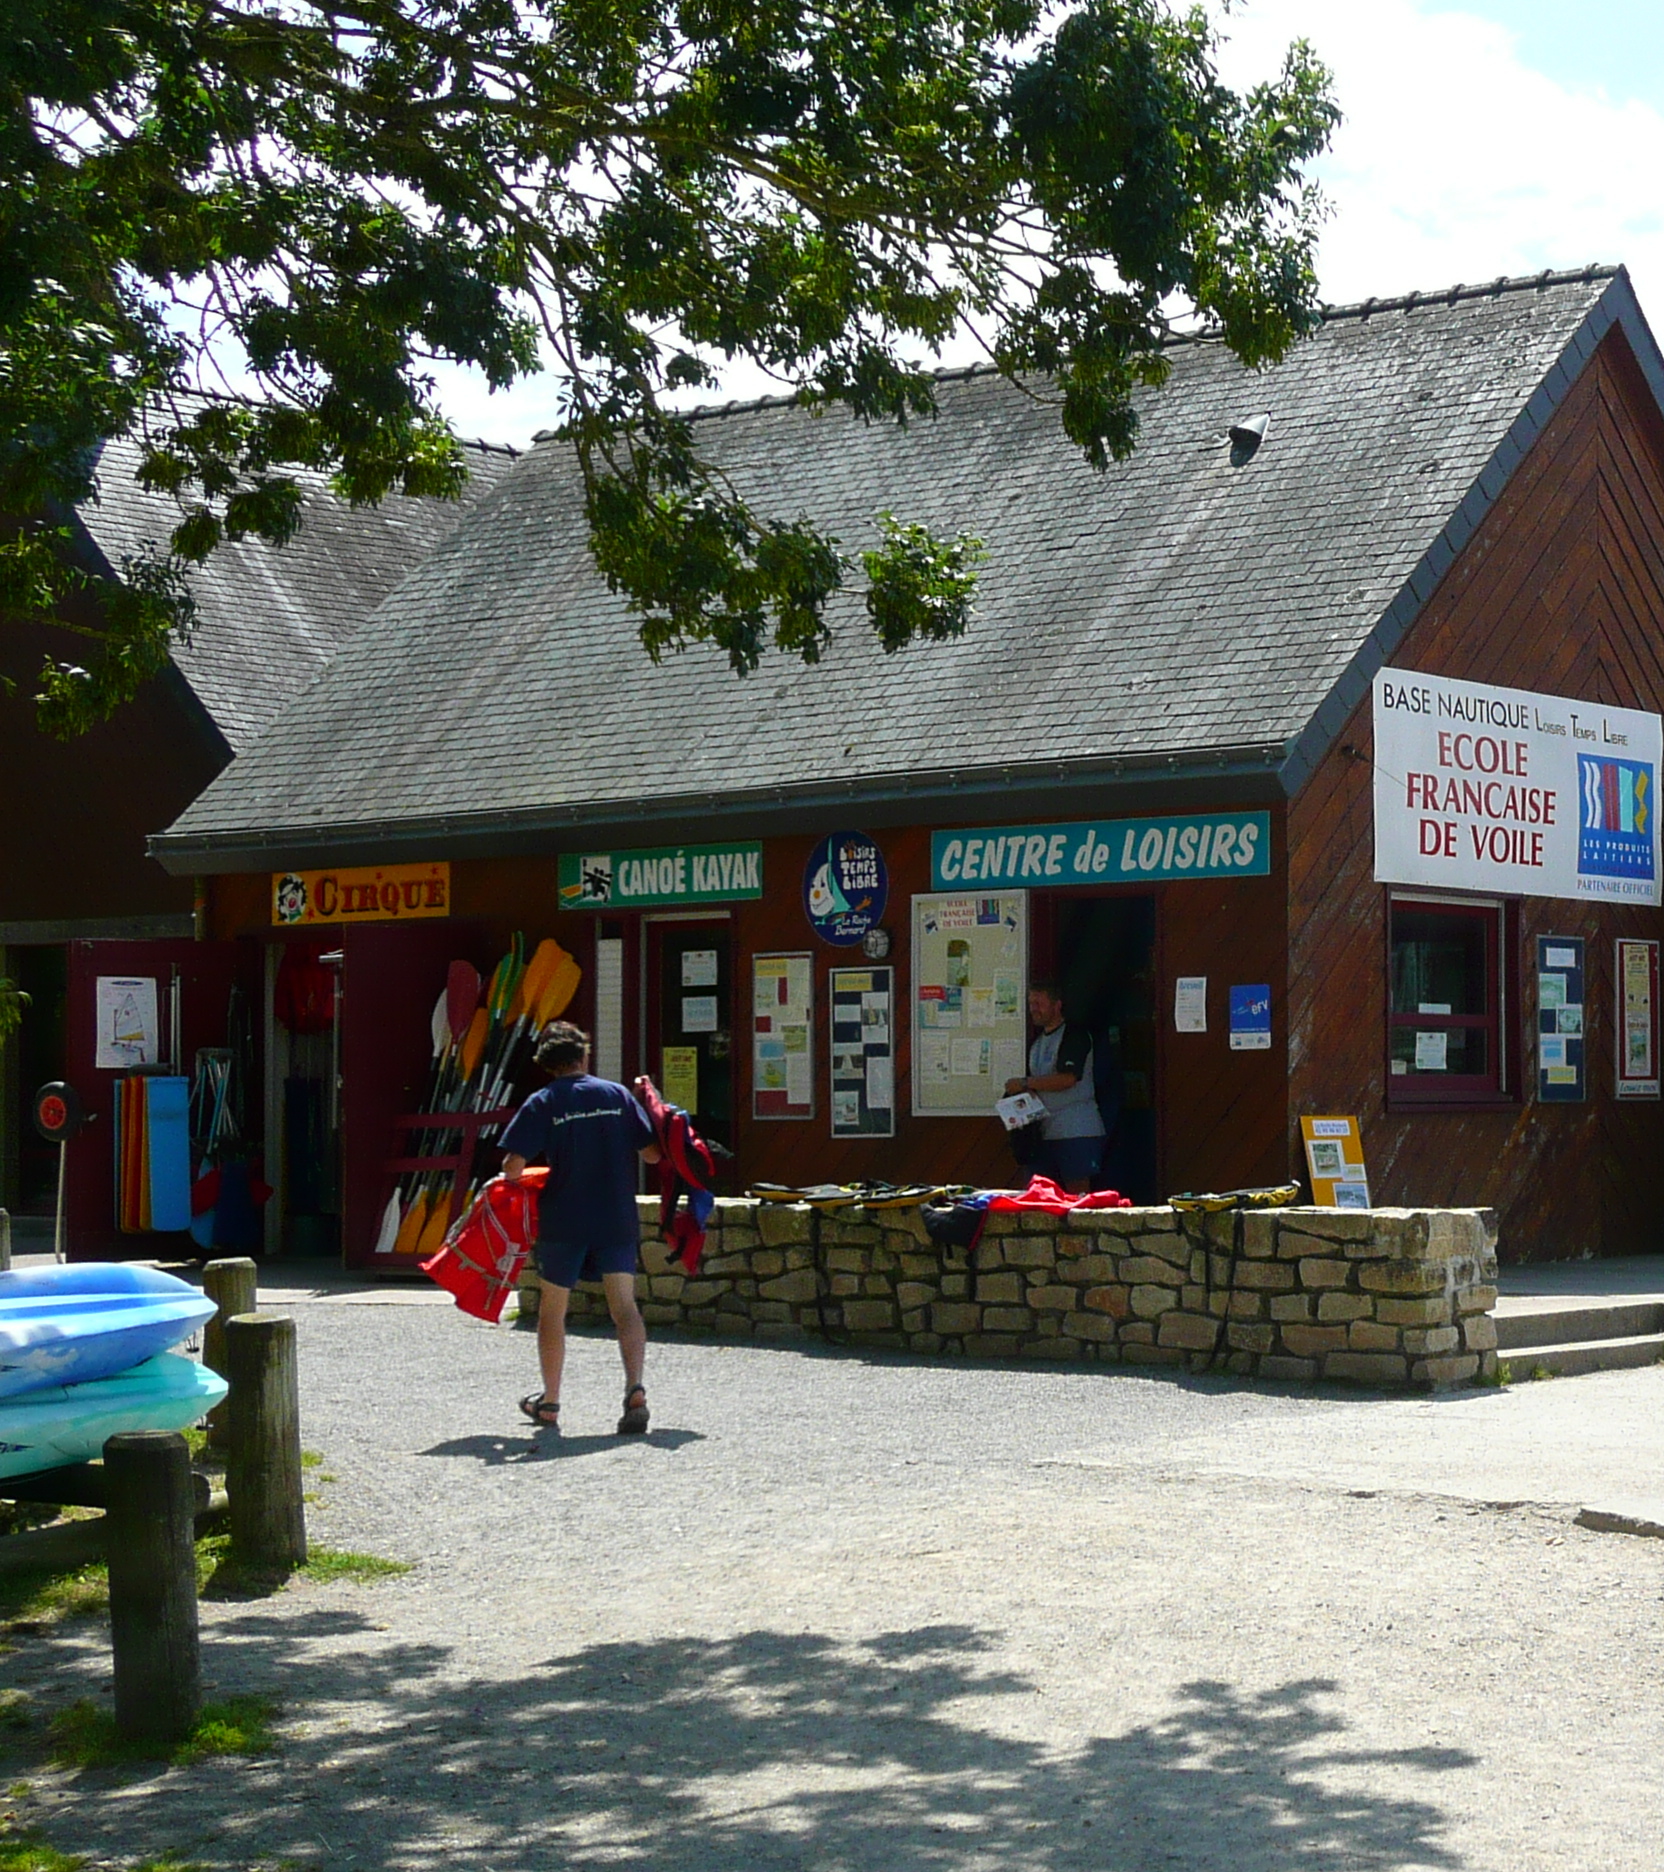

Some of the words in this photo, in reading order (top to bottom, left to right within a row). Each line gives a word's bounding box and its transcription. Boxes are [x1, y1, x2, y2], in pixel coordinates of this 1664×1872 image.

[1384, 683, 1431, 714] BASE
[1438, 692, 1529, 729] NAUTIQUE
[1438, 731, 1528, 777] ECOLE
[1406, 772, 1557, 825] FRANCAISE
[940, 833, 1067, 881] CENTRE
[1073, 829, 1109, 874] de
[1120, 823, 1259, 871] LOISIRS
[1418, 818, 1458, 858] DE
[1471, 824, 1543, 867] VOILE
[1583, 839, 1600, 849] LES
[1606, 842, 1651, 855] PRODUITS
[314, 875, 445, 916] CIRQUE
[618, 850, 686, 897] CANOÉ
[692, 852, 759, 892] KAYAK
[1577, 879, 1621, 893] PARTENAIRE
[1622, 882, 1653, 896] OFFICIEL
